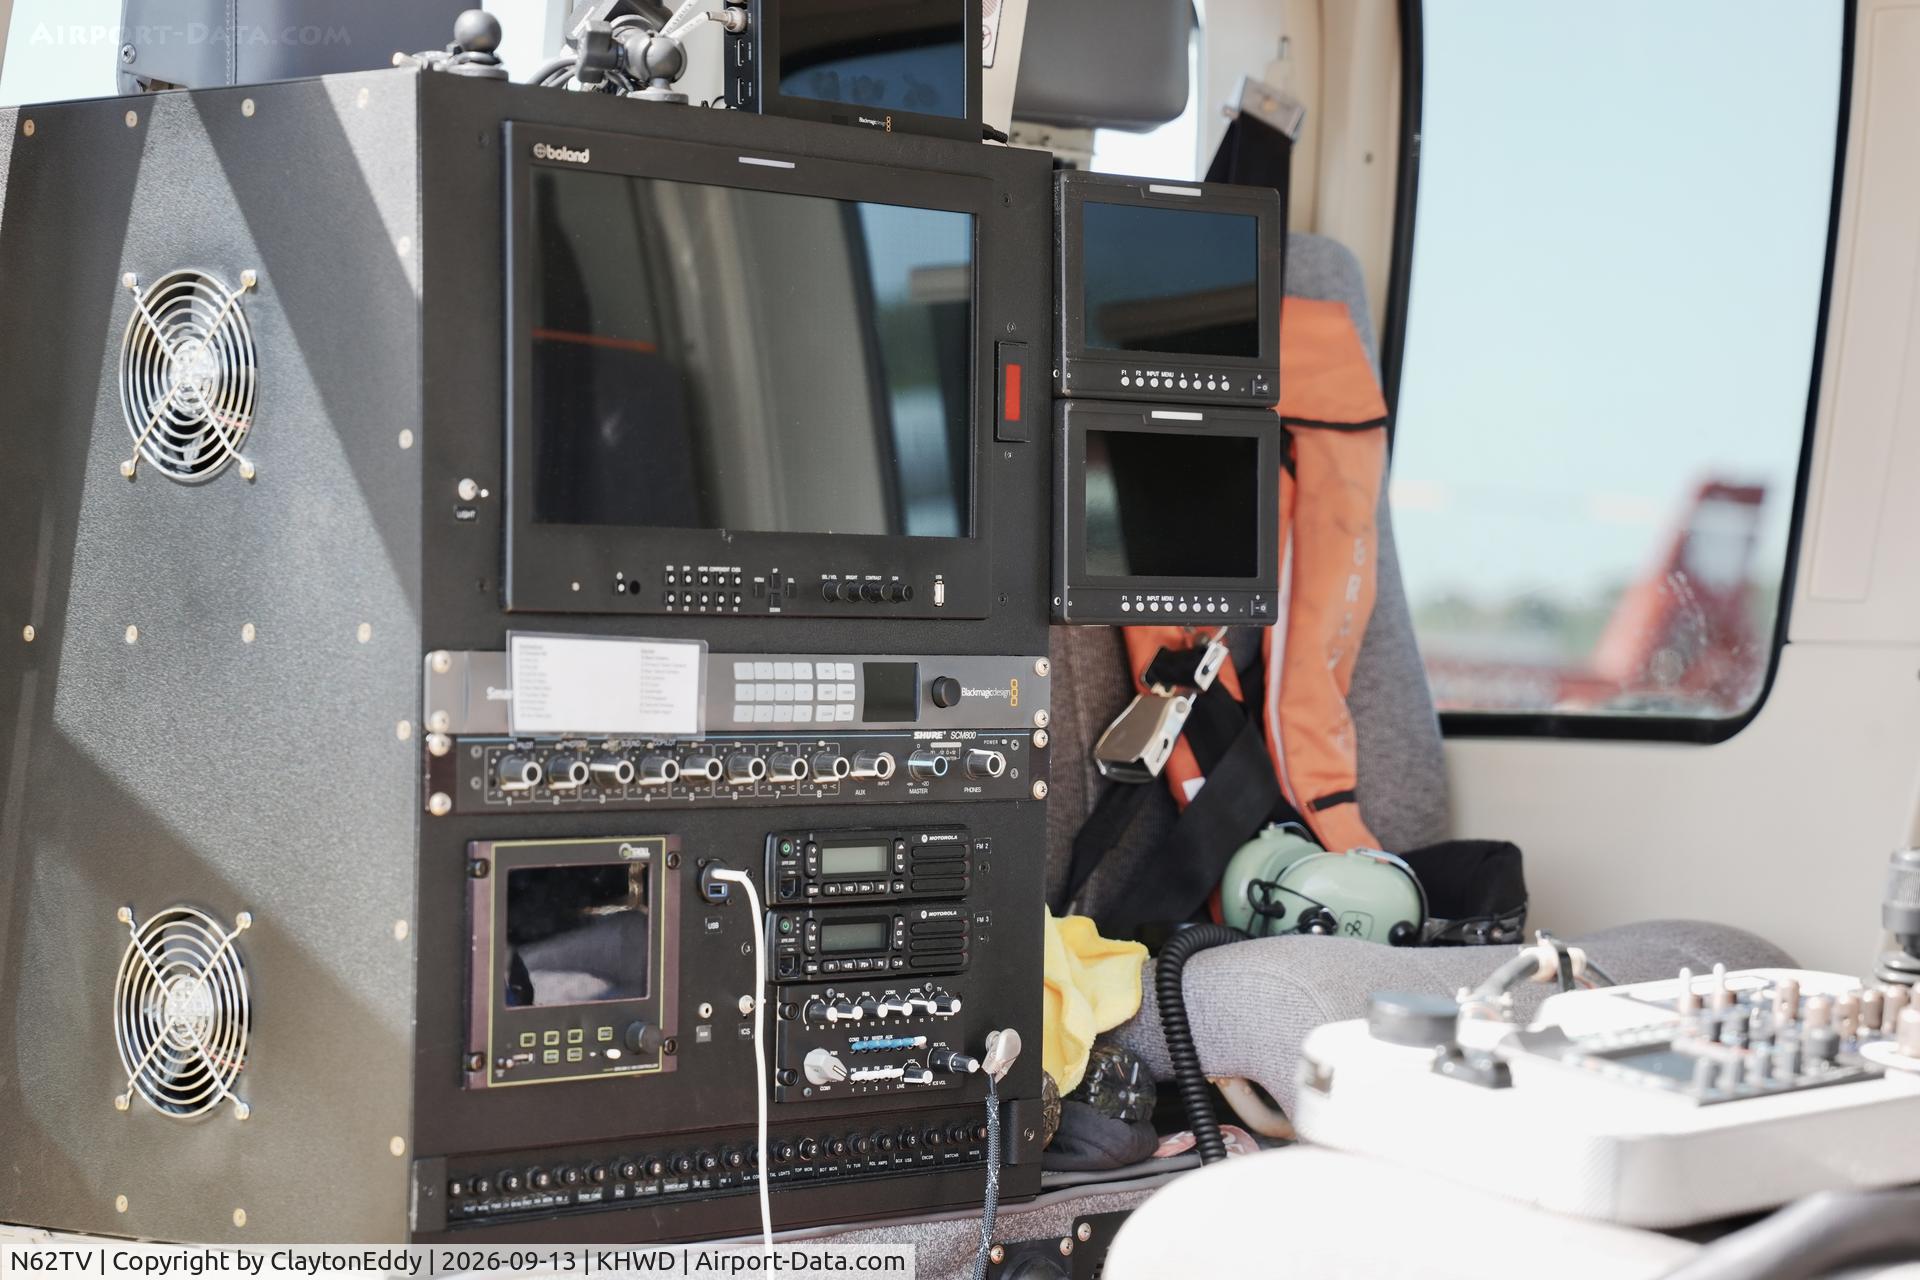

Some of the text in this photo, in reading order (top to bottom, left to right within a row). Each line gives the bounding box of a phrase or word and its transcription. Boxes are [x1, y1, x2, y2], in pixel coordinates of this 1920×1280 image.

[546, 144, 590, 163] boland
[961, 687, 1011, 699] Blackmagicdesign
[913, 731, 977, 739] SHURE SCM800
[928, 834, 958, 842] MOTOROLA
